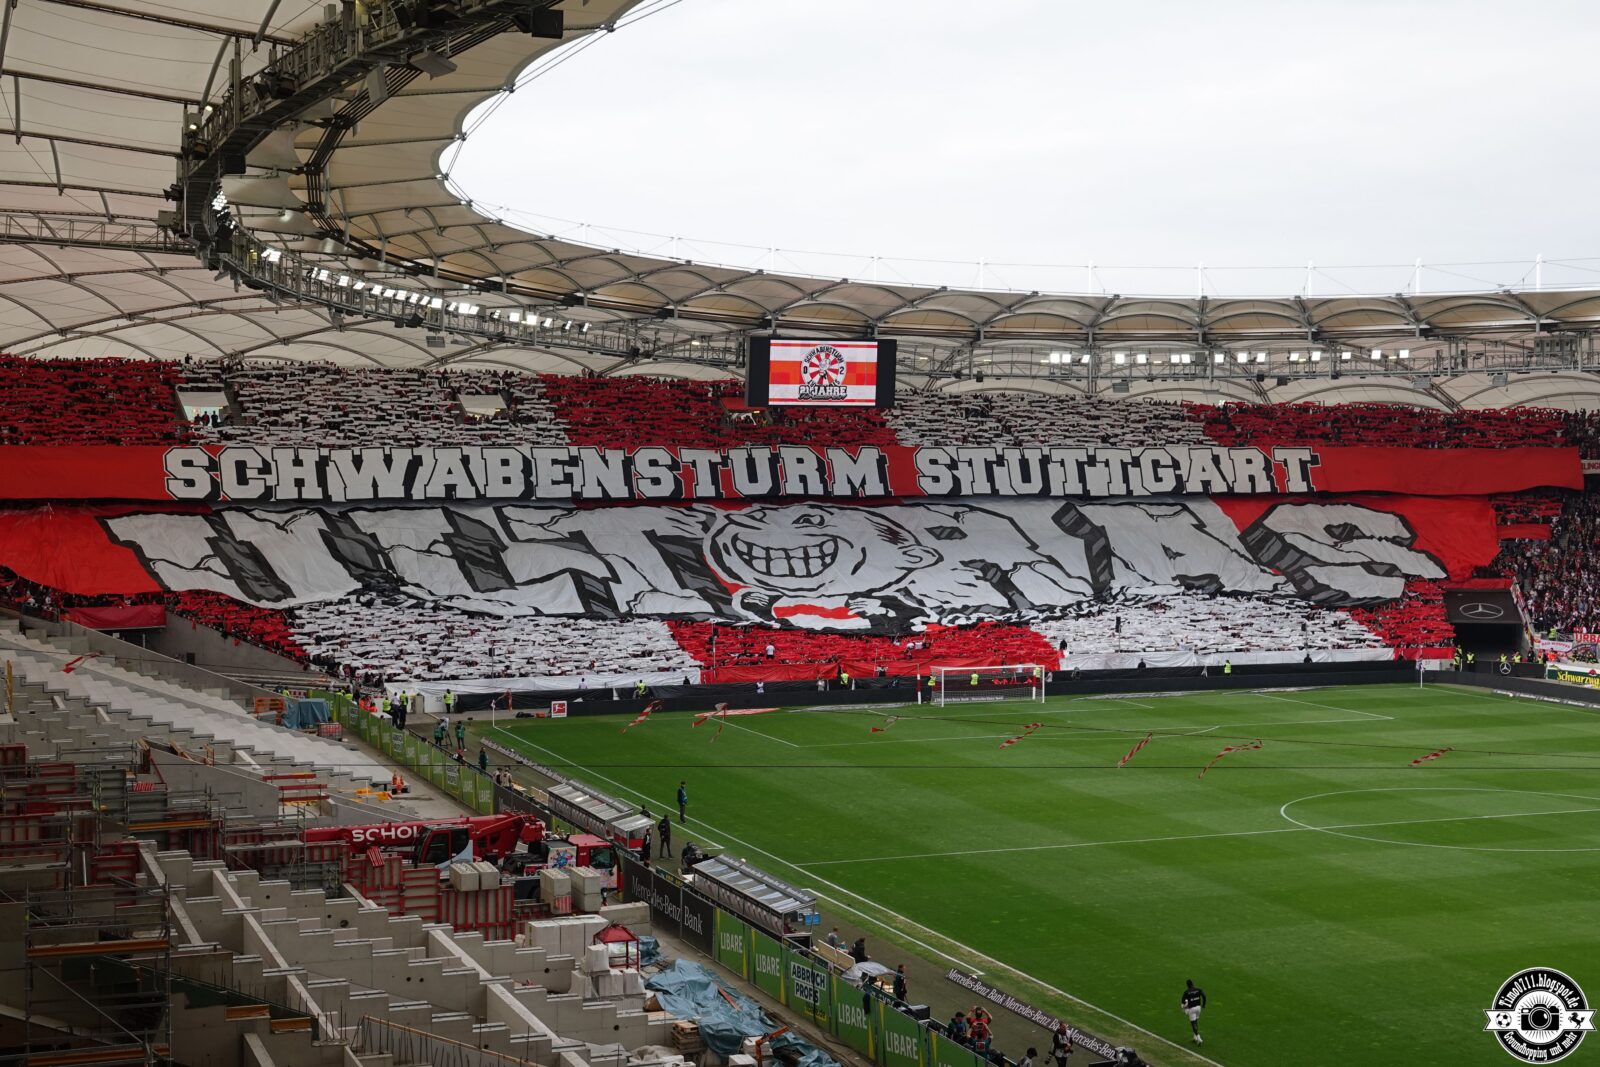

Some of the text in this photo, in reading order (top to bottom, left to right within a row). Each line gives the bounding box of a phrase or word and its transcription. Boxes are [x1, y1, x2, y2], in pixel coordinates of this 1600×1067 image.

[804, 346, 845, 364] SCHWABENSTURM
[811, 386, 847, 396] JAHRE
[164, 446, 1320, 500] SCHWABENSTURM STUTTGART
[632, 875, 681, 922] Mercedes-Benz
[684, 906, 703, 936] Bank
[720, 932, 742, 953] LIBARE
[756, 954, 780, 976] LIBARE
[838, 1002, 868, 1030] LIBARE
[947, 968, 990, 998] Mercedes-Benz
[987, 988, 1004, 1006] Bank
[1003, 996, 1050, 1028] Mercedes-Benz
[1070, 1027, 1116, 1060] Mercedes-Ben
[886, 1031, 918, 1060] LIBARE
